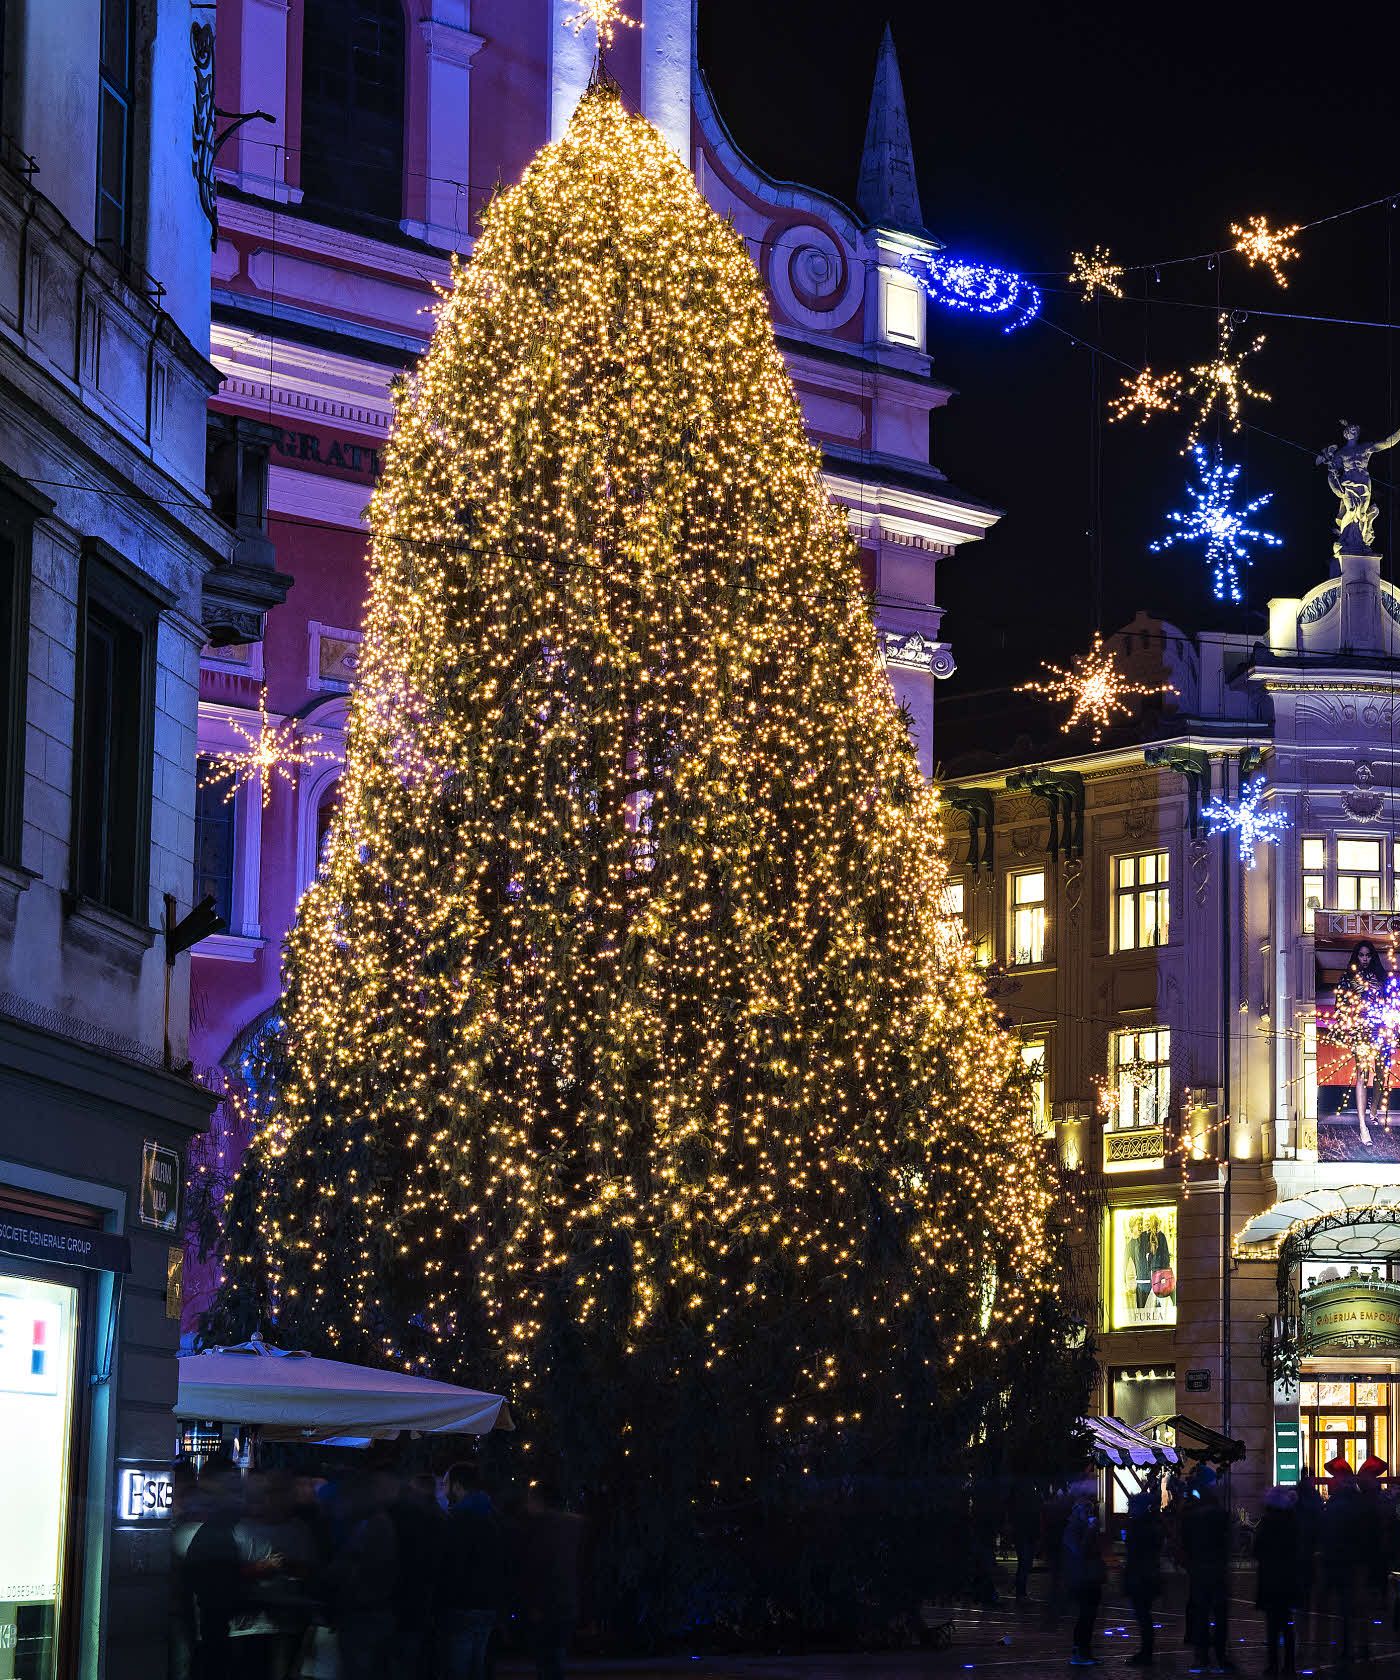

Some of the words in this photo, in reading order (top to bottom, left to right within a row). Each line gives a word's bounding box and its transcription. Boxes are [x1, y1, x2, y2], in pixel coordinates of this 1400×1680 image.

[29, 1230, 66, 1249] GENERALE
[67, 1237, 91, 1254] GROUP
[1134, 1311, 1163, 1322] FURLA
[1315, 1311, 1356, 1327] GALERIJA
